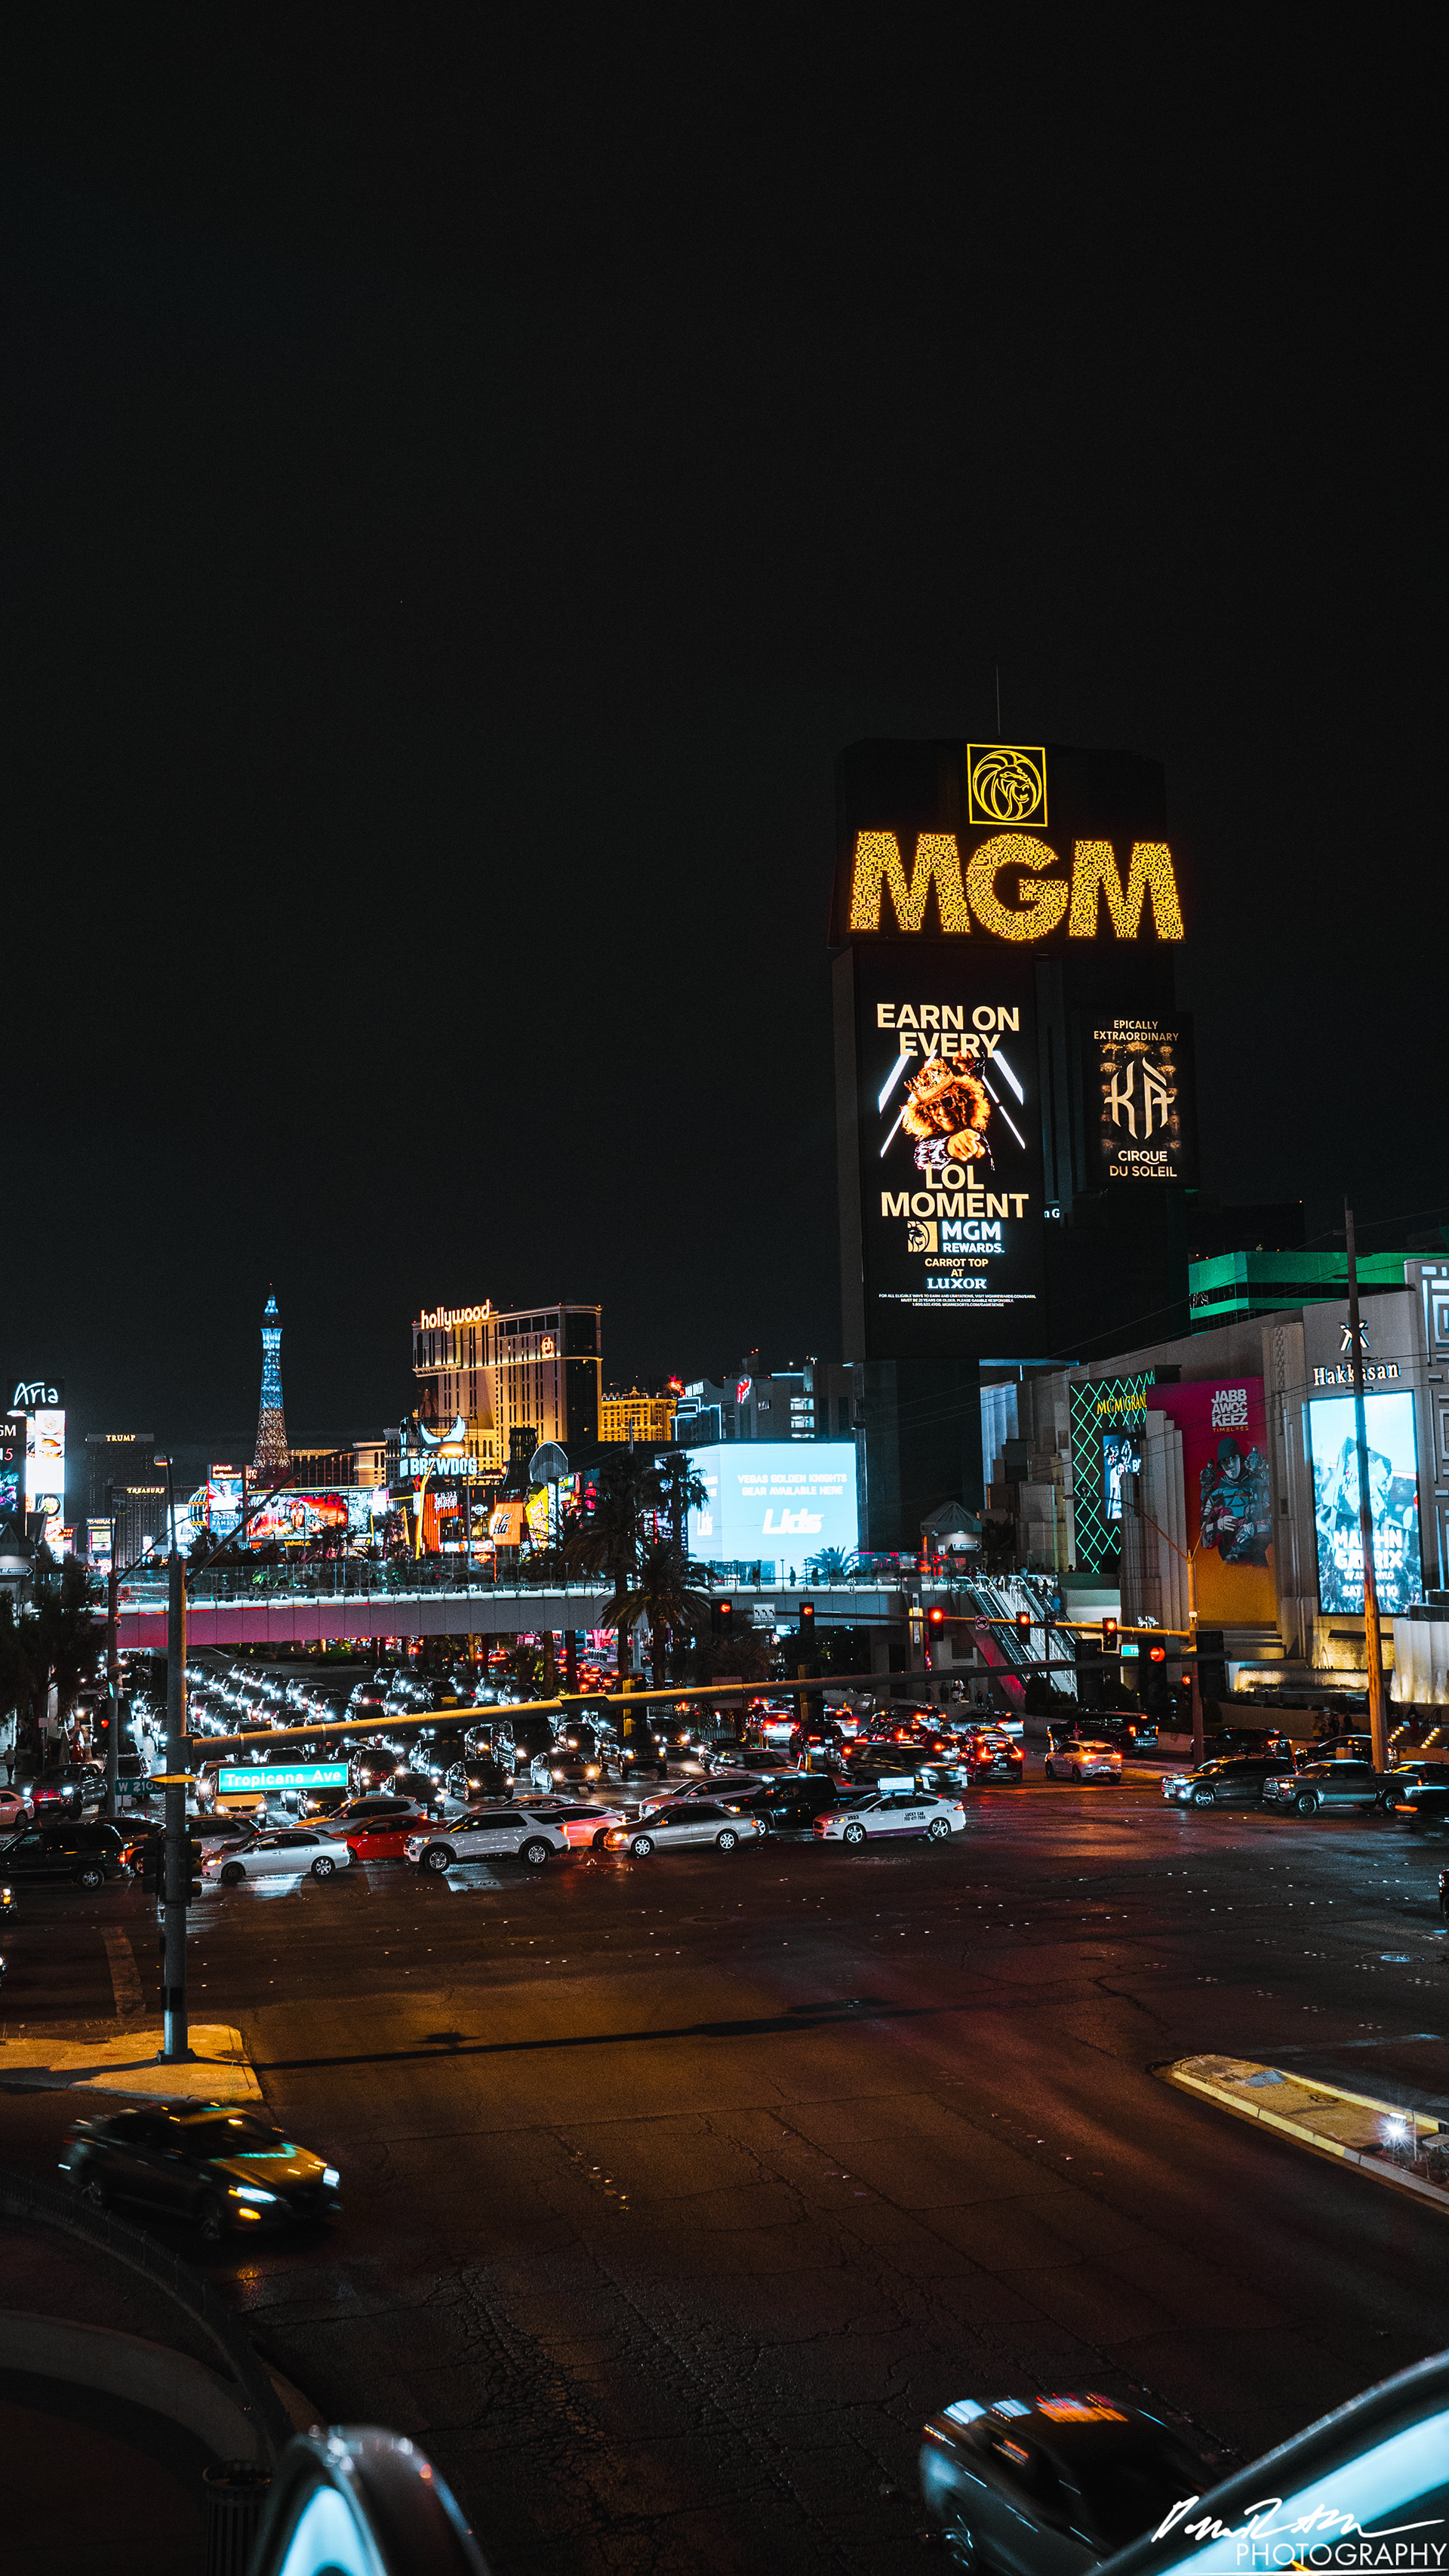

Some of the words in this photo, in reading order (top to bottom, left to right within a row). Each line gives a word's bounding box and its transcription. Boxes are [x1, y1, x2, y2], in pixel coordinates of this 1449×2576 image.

[848, 830, 1186, 941] MGM
[877, 1003, 964, 1030] EARN
[972, 1006, 1020, 1032] ON
[1113, 1020, 1158, 1030] EPICALLY
[1094, 1030, 1179, 1042] EXTRAORDINARY
[900, 1031, 1001, 1058] EVERY
[1118, 1150, 1168, 1165] CIRQUE
[925, 1164, 984, 1190] LOL
[1109, 1165, 1128, 1177] DU
[1132, 1166, 1177, 1177] SOLEIL
[881, 1192, 1029, 1218] MOMENT
[942, 1220, 1001, 1241] MGM
[924, 1257, 967, 1267] CARROT
[968, 1258, 989, 1267] TOP
[950, 1268, 964, 1277] AT
[927, 1278, 986, 1289] LUXOR
[421, 1298, 490, 1332] hollywood
[13, 1382, 59, 1406] Aria
[1211, 1389, 1247, 1404] JABB
[1097, 1397, 1123, 1415] MGM
[1211, 1402, 1247, 1414] AWOC
[1211, 1412, 1248, 1427] KEEZ
[410, 1457, 478, 1476] BREWDOG
[737, 1474, 768, 1484] VEGAS
[771, 1474, 806, 1483] GOLDEN
[808, 1473, 848, 1483] KNIGHTS
[742, 1486, 767, 1496] GEAR
[769, 1486, 817, 1495] AVAILABLE
[820, 1485, 843, 1495] HERE
[1342, 1585, 1362, 1597] SAT
[226, 1772, 304, 1788] Tropicana
[312, 1770, 341, 1783] Ave
[118, 1782, 128, 1792] W
